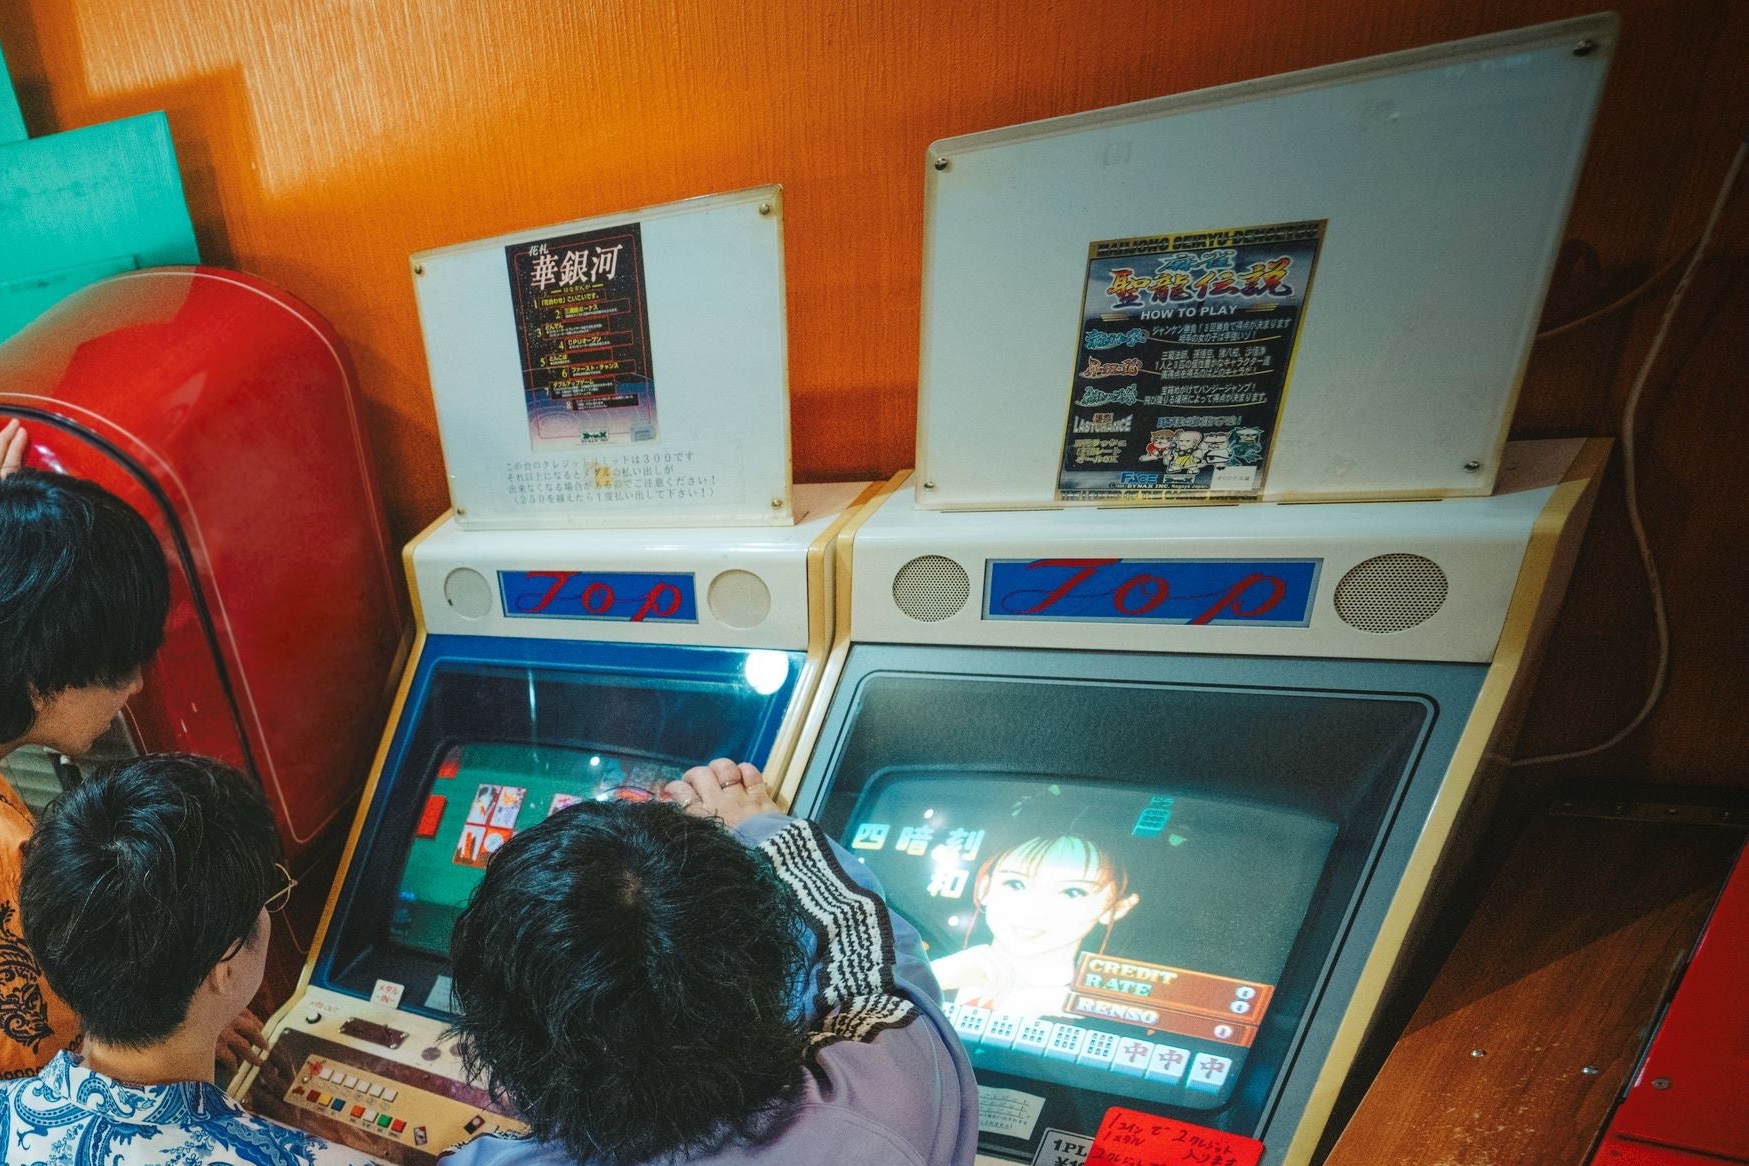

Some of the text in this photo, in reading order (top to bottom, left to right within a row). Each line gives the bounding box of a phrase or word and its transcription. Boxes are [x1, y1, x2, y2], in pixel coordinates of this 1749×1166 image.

[529, 243, 549, 257] 花札
[1157, 249, 1238, 272] 麻雀
[531, 244, 623, 291] 華銀河
[1105, 255, 1294, 310] 聖龍伝説
[1140, 304, 1239, 321] HOW TO PLAY
[561, 368, 568, 378] 6
[1120, 472, 1159, 484] FACE
[514, 569, 684, 623] Top
[1002, 557, 1289, 626] Top
[852, 823, 985, 862] 四暗刻
[1083, 973, 1153, 997] RATE
[1088, 958, 1178, 985] CREDIT
[1075, 997, 1159, 1025] RENSO
[1124, 1042, 1226, 1079] 中 中 中
[1053, 1139, 1088, 1156] 1PL
